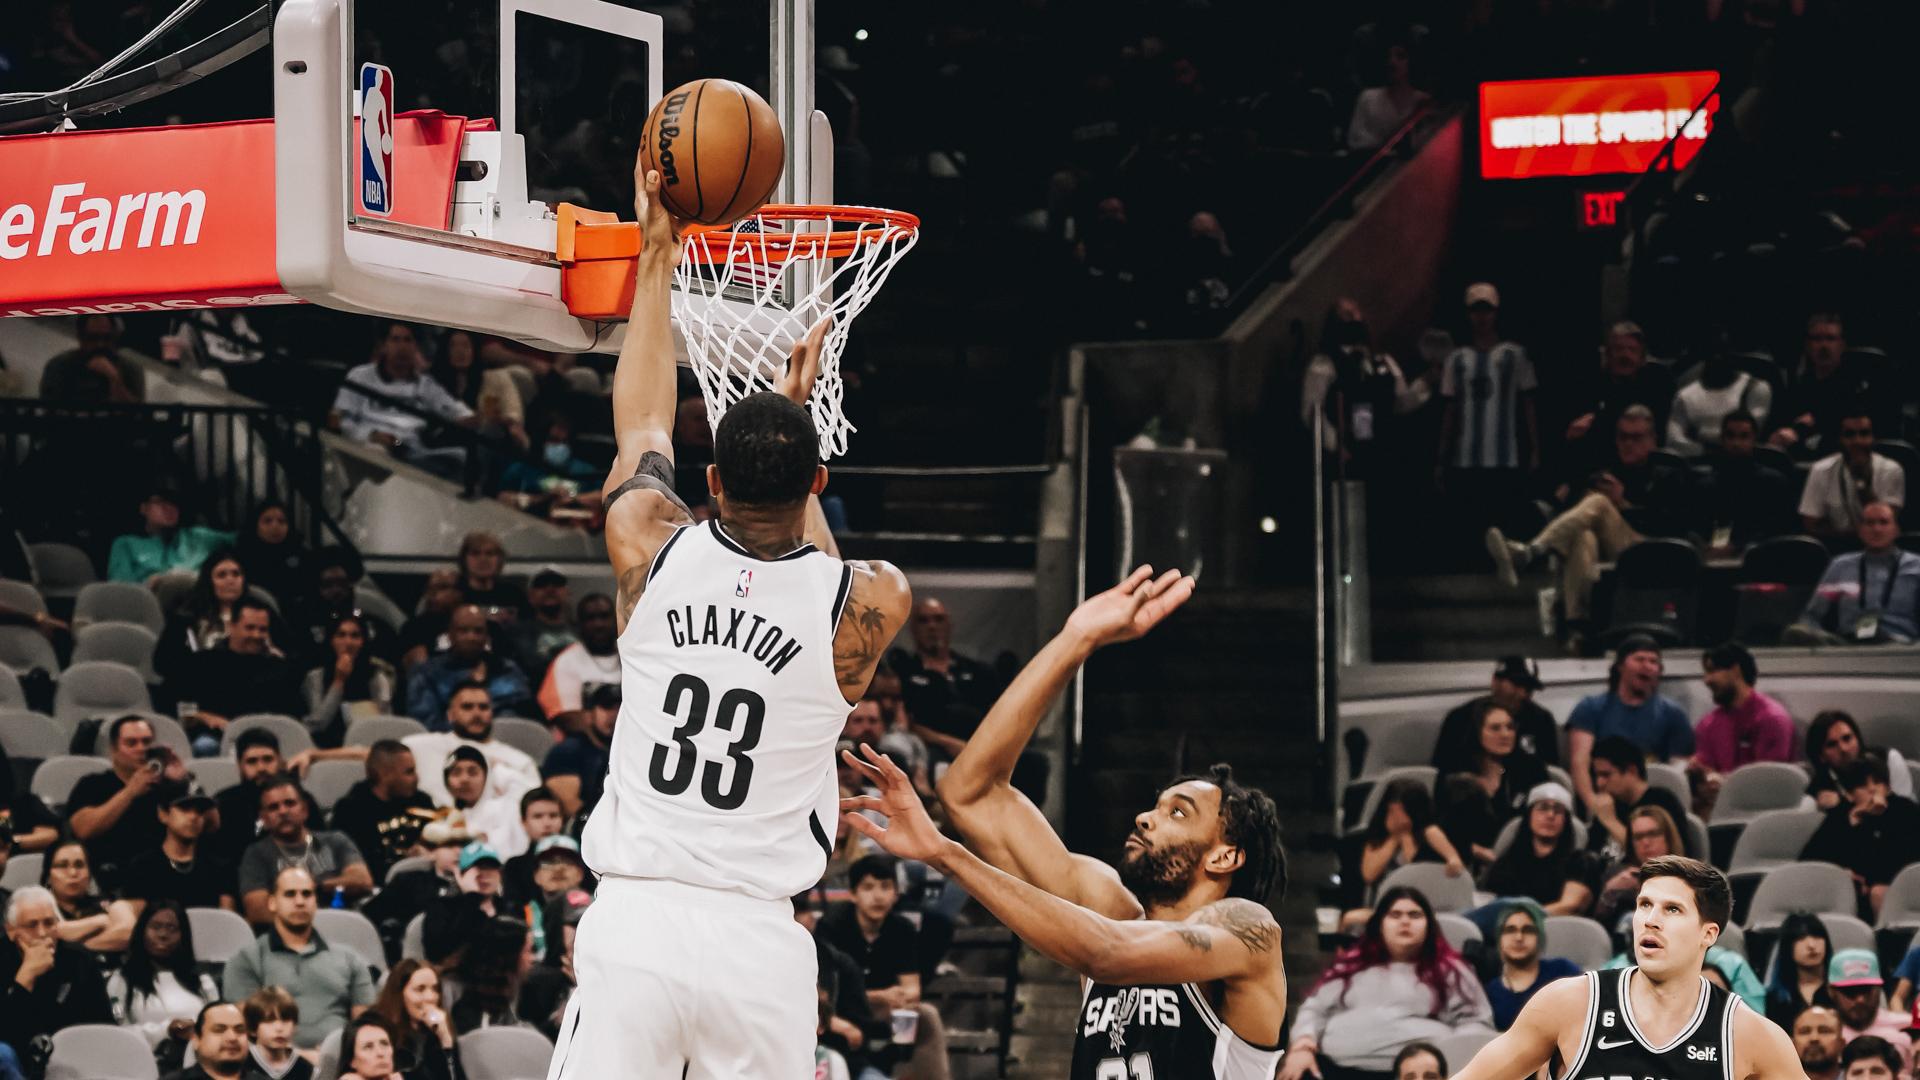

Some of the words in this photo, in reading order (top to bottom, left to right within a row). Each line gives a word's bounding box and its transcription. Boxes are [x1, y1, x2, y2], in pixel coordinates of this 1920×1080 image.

[659, 91, 691, 187] Wilson
[365, 180, 382, 206] NBA
[667, 604, 803, 676] CLAXTON
[648, 673, 766, 811] 33
[1602, 1011, 1616, 1028] 6
[1687, 1045, 1718, 1062] Self.
